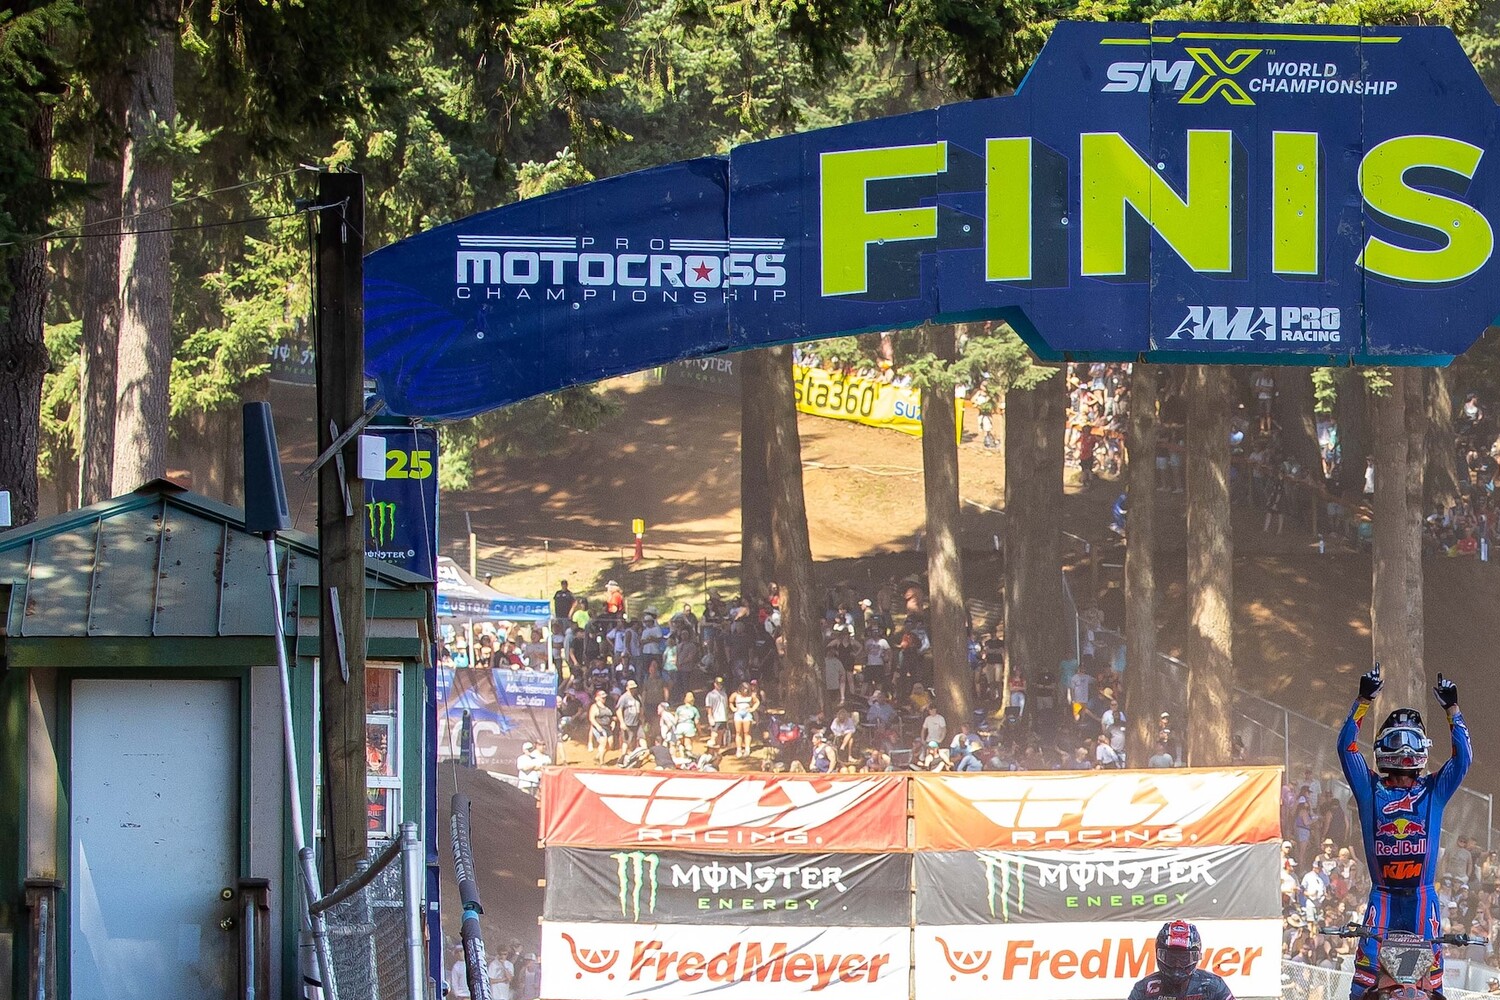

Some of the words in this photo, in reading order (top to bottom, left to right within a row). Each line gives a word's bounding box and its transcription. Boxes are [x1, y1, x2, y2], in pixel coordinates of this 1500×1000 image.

[1101, 47, 1263, 106] SMX
[1267, 61, 1337, 78] WORLD
[1248, 78, 1398, 95] CHAMPIONSHIP
[581, 237, 665, 251] PRO
[456, 251, 787, 288] MOTOCROSS
[456, 287, 787, 303] CHAMPIONSHIP
[1165, 305, 1277, 341] AMA
[1281, 306, 1341, 330] PRO
[1281, 330, 1341, 342] RACING
[365, 549, 405, 559] ONSTER
[573, 772, 893, 829] FLY
[941, 774, 1250, 828] FLY
[1375, 838, 1401, 856] Red
[1402, 838, 1427, 856] Bull
[670, 861, 848, 894] MONSTER
[1037, 858, 1218, 892] MONSTER
[1383, 860, 1422, 880] KTM
[697, 897, 820, 911] ENERGY
[1066, 894, 1189, 908] ENERGY
[1396, 949, 1421, 977] 1
